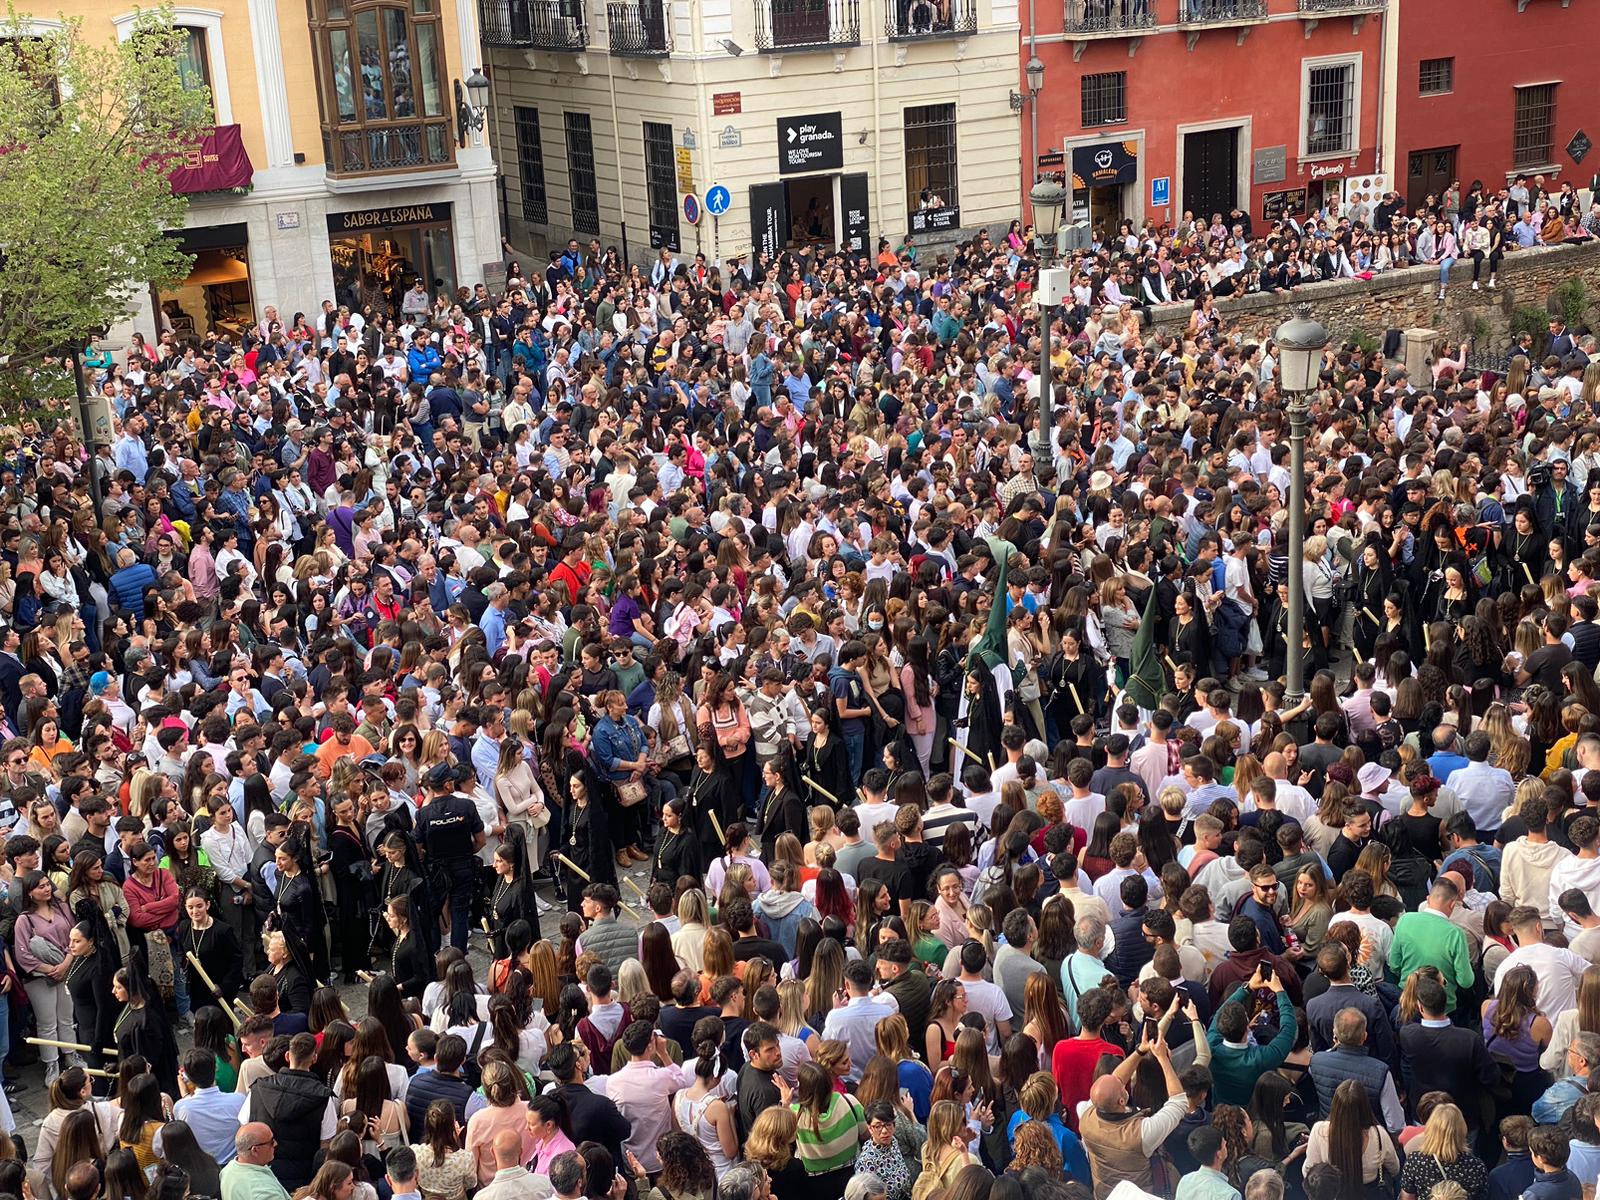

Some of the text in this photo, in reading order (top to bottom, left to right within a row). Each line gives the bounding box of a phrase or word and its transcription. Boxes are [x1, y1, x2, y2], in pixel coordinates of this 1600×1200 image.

[800, 124, 817, 135] play
[800, 130, 835, 144] granada.
[800, 151, 823, 159] TOURISM
[1155, 179, 1167, 191] AT
[343, 211, 381, 228] SABOR
[390, 206, 434, 223] ESPAÑA
